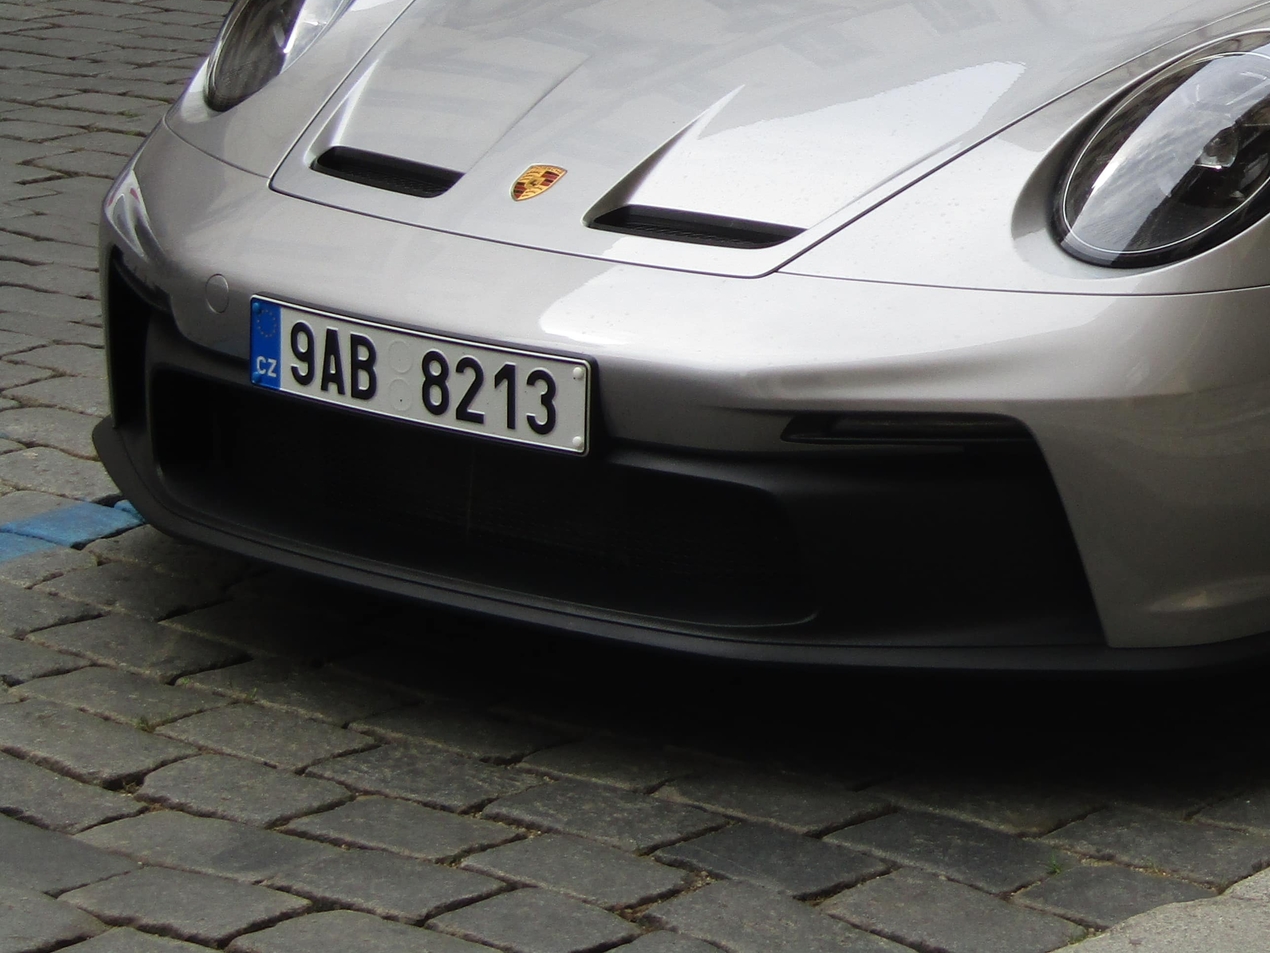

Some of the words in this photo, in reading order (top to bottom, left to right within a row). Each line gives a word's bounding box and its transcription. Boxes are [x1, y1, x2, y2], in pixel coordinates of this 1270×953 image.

[256, 355, 277, 378] CZ
[290, 321, 377, 400] 9AB
[421, 350, 557, 435] 8213
